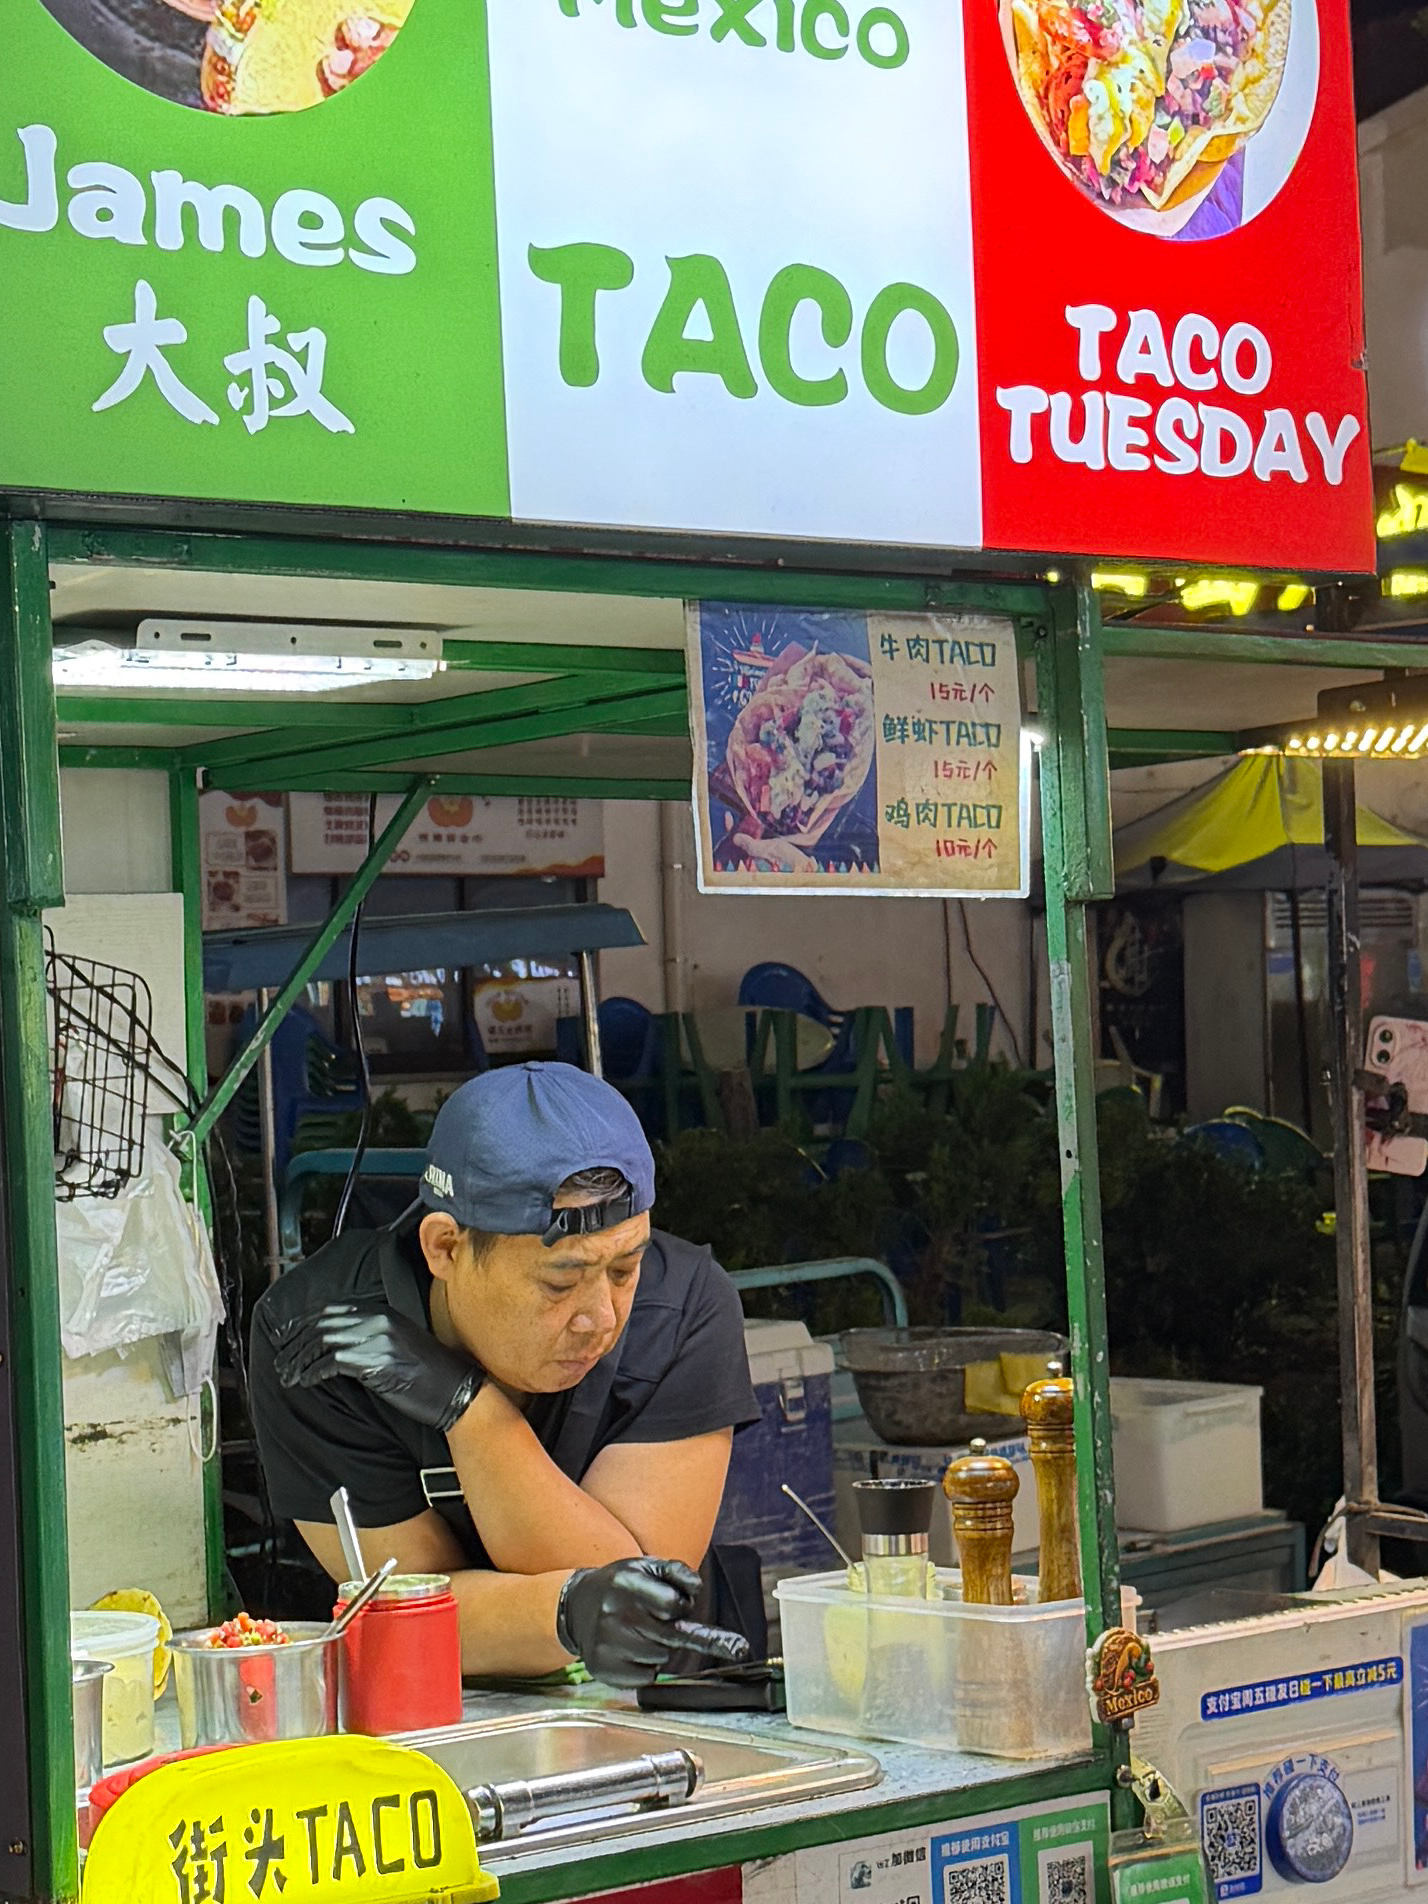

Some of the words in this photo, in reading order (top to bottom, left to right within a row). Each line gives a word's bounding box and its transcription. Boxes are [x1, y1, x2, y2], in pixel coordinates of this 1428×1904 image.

[526, 240, 959, 417] TACO
[93, 280, 357, 437] 大叔
[1064, 302, 1273, 396] TACO
[995, 386, 1361, 487] TUESDAY
[880, 633, 996, 667] 牛肉TACO
[930, 681, 996, 702] 15元/个
[882, 714, 1001, 749] 鲜虾TACO
[933, 760, 998, 781] 15元/个
[884, 799, 1003, 831] 鸡肉TACO
[935, 839, 998, 859] 10元/个
